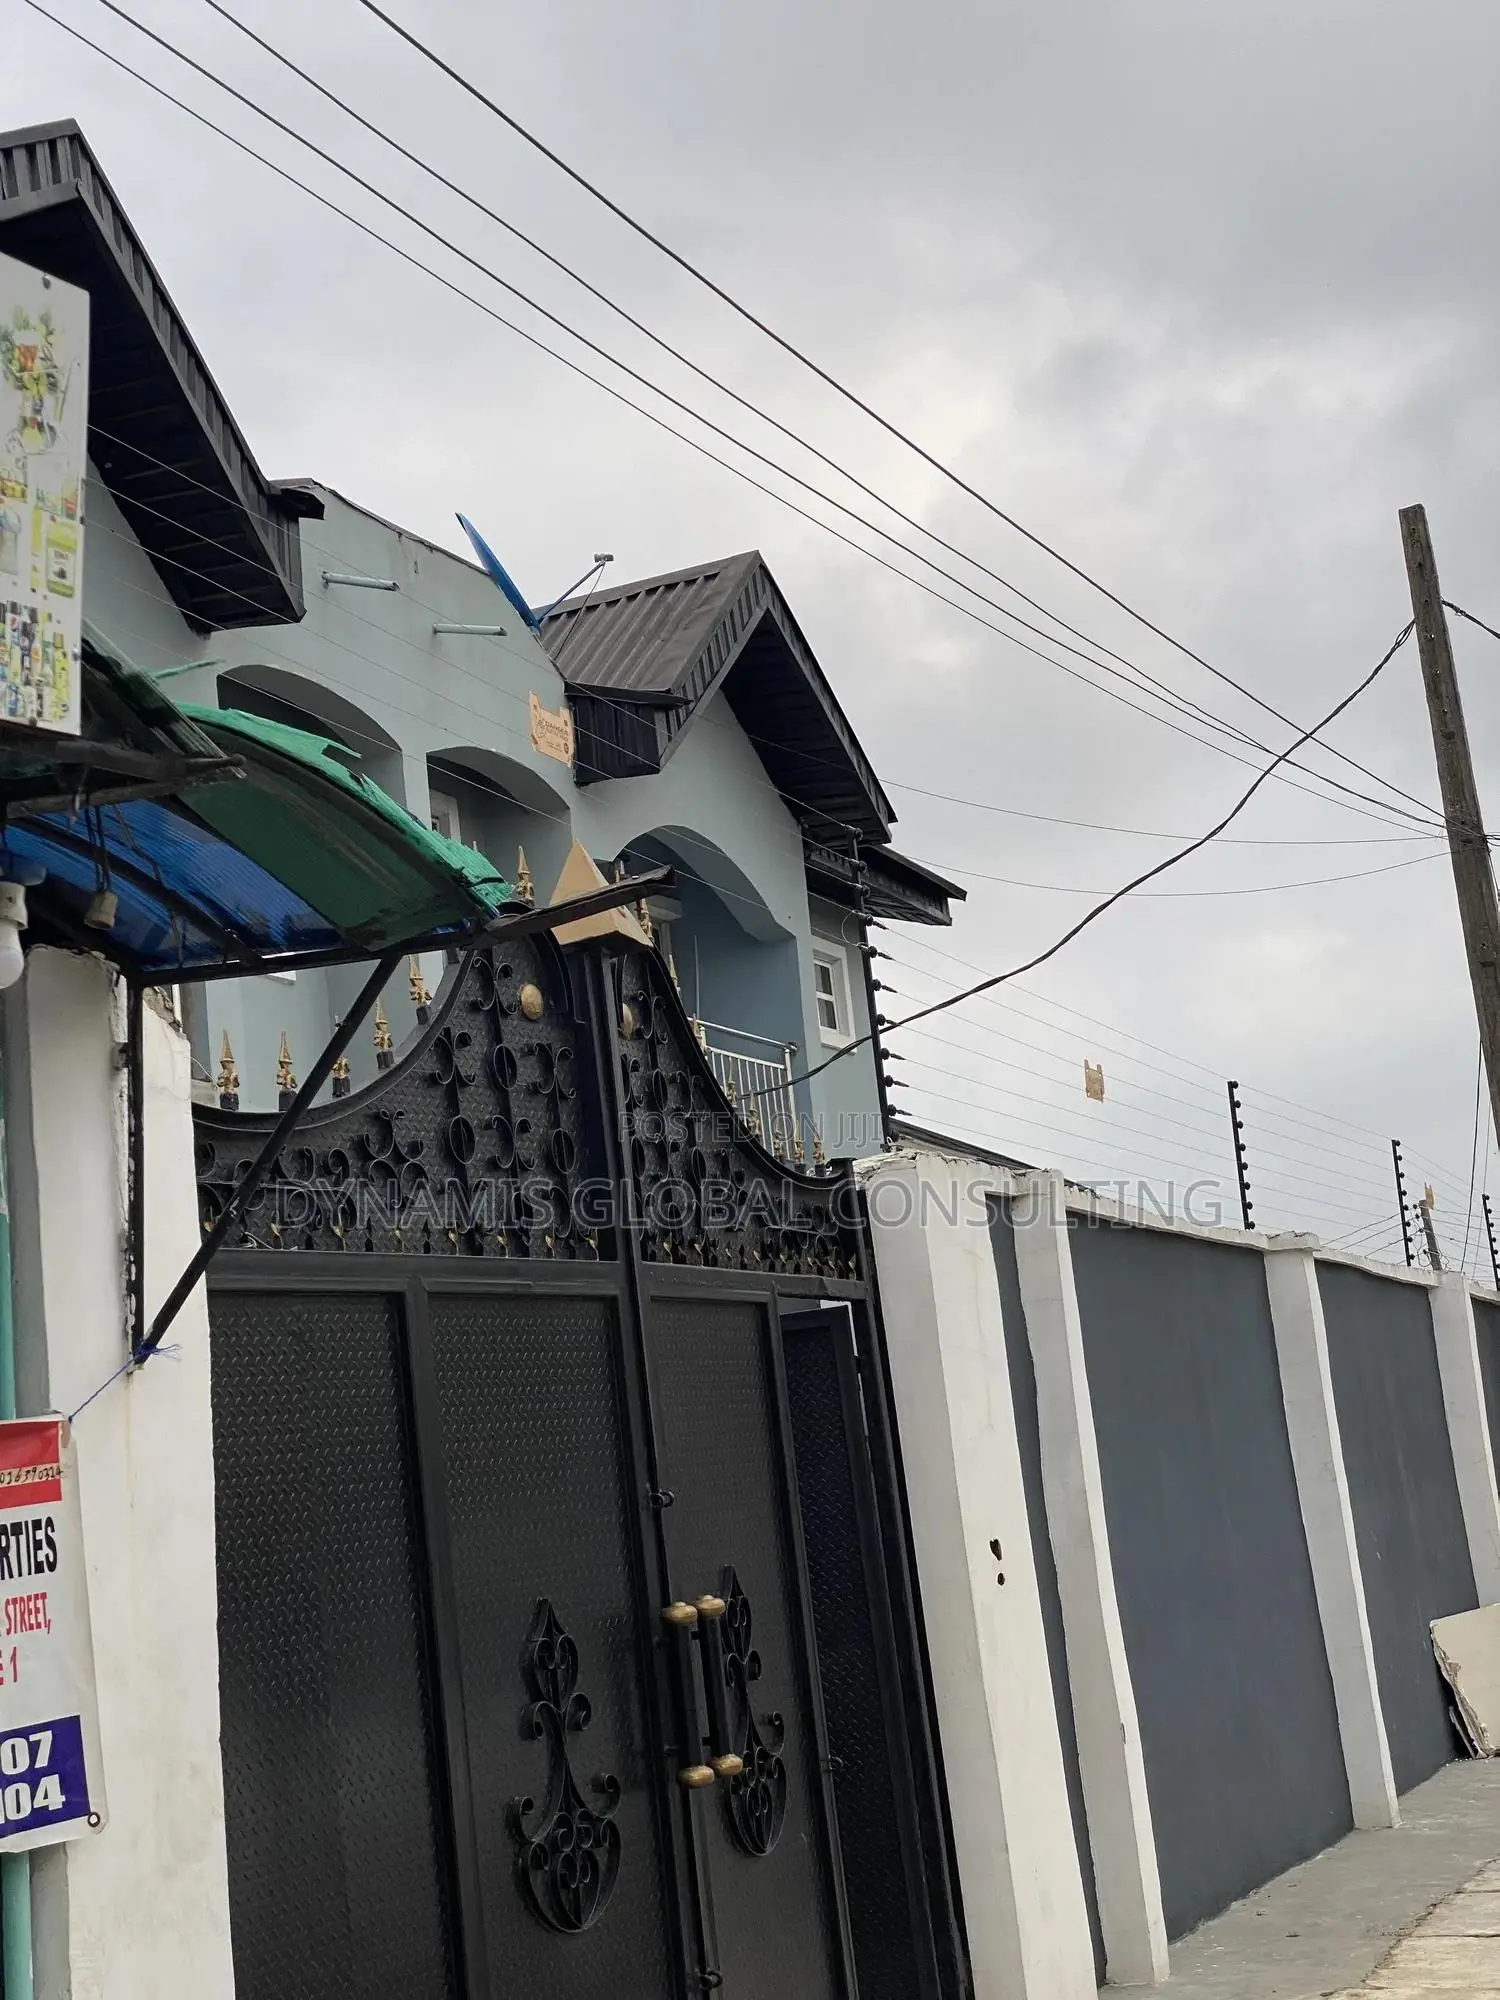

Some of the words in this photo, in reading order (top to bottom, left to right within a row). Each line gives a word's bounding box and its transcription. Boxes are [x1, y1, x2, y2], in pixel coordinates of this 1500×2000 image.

[0, 1516, 57, 1580] RTIES
[4, 1591, 51, 1636] STREET,
[0, 1730, 53, 1775] 07
[0, 1774, 66, 1824] 04
